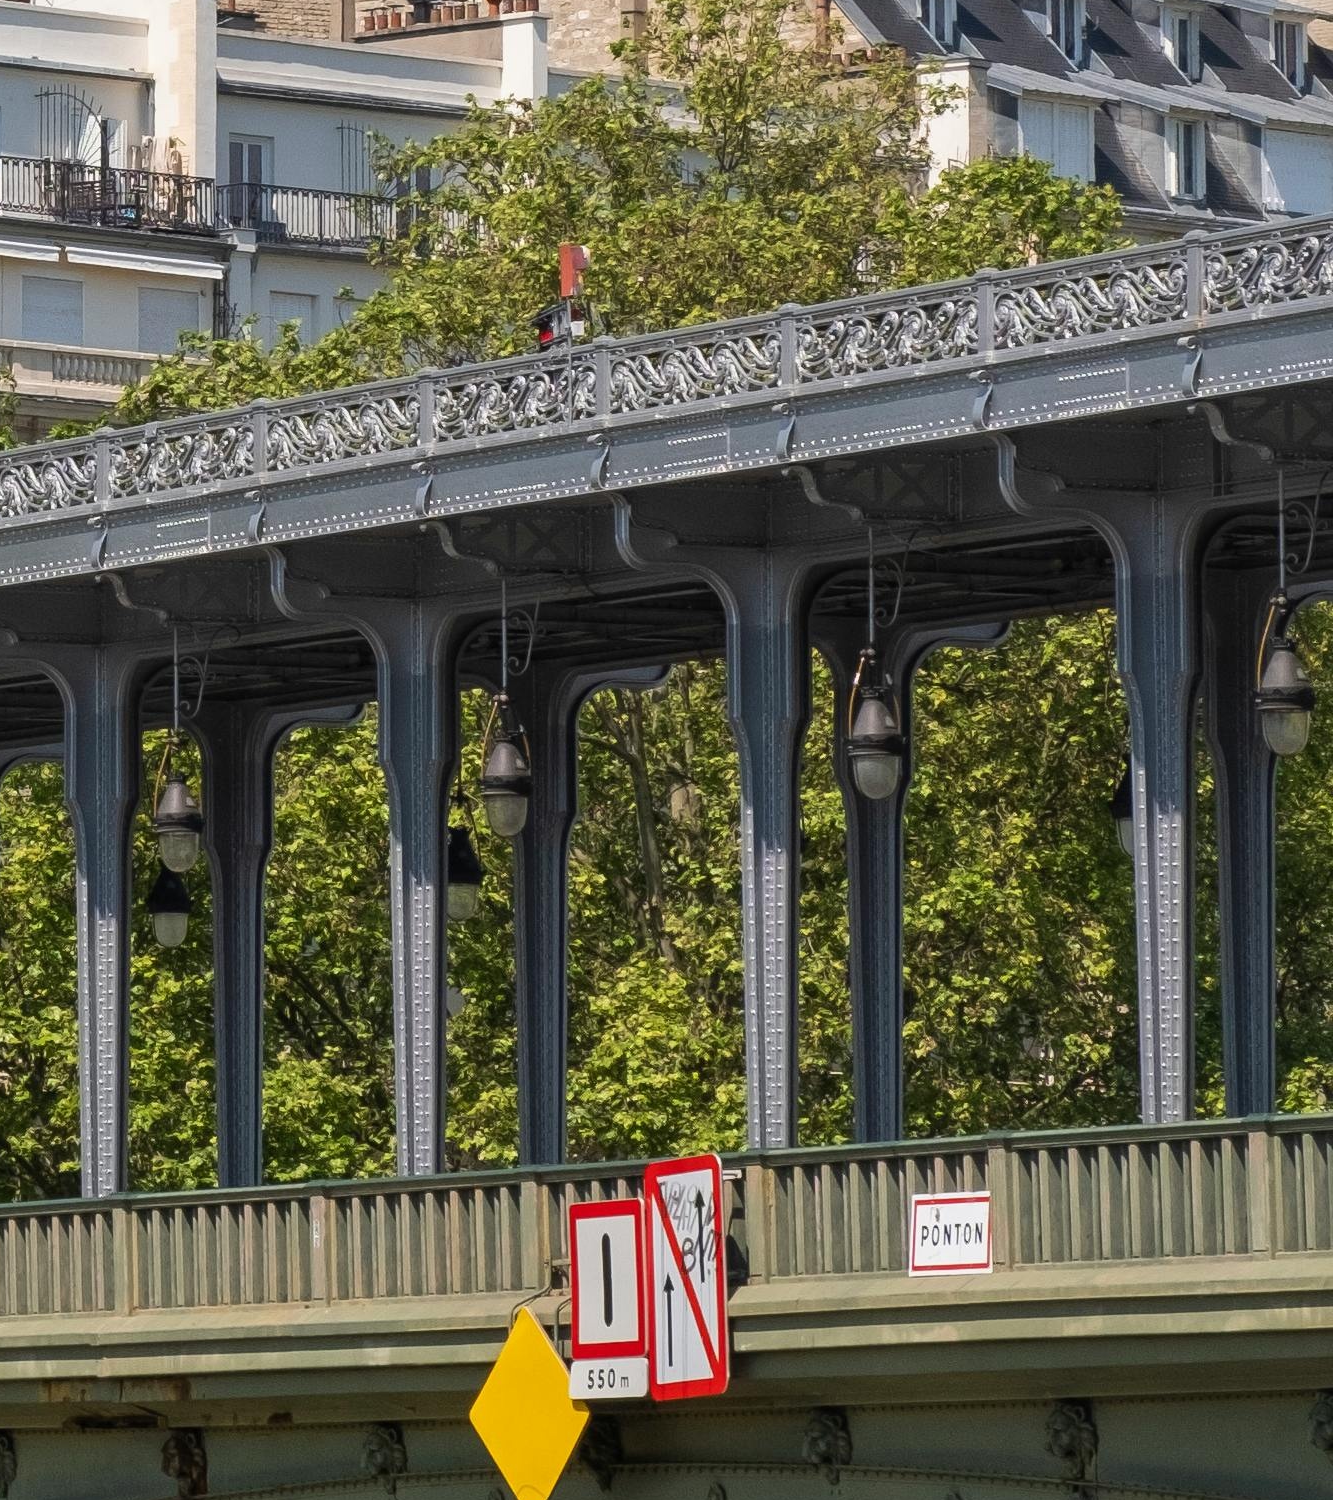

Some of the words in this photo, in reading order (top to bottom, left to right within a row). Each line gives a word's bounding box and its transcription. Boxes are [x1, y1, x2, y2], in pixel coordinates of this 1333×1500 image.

[921, 1222, 983, 1247] PONTON
[587, 1368, 616, 1390] 550
[620, 1376, 630, 1388] m
